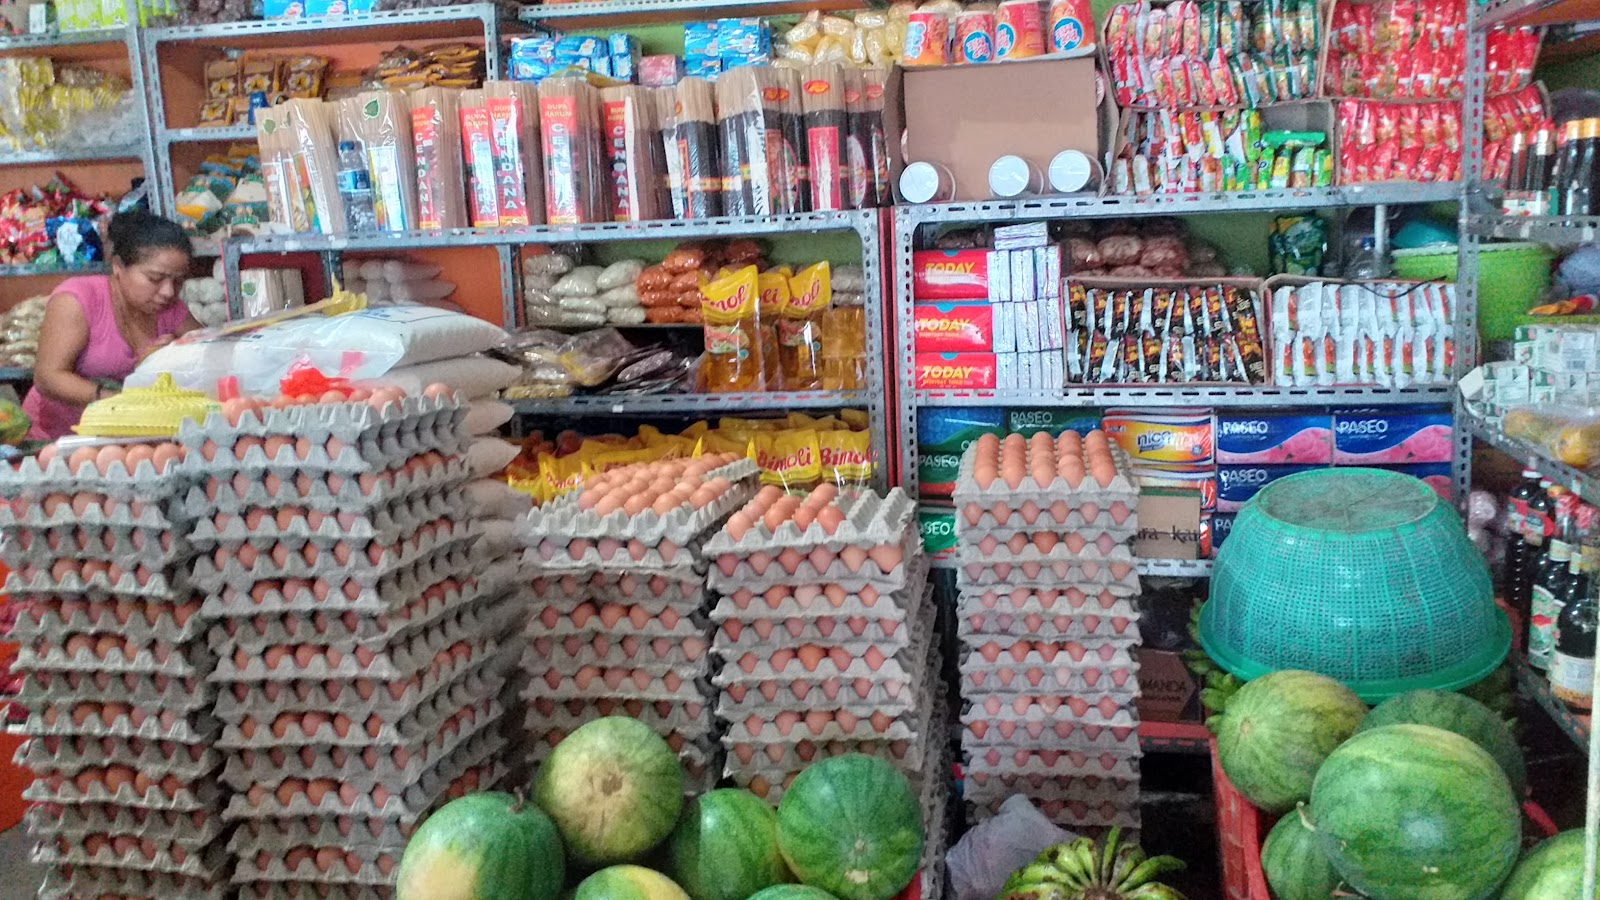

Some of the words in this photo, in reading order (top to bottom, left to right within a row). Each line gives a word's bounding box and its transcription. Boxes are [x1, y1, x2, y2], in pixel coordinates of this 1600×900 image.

[415, 132, 430, 215] CENDANA
[918, 318, 970, 332] TODAY
[921, 365, 973, 379] TODAY
[1011, 411, 1053, 424] PASEO
[1222, 420, 1269, 435] PASEO
[1338, 419, 1389, 434] PASEO
[757, 447, 812, 472] Bimoli
[1221, 469, 1268, 483] PASEO
